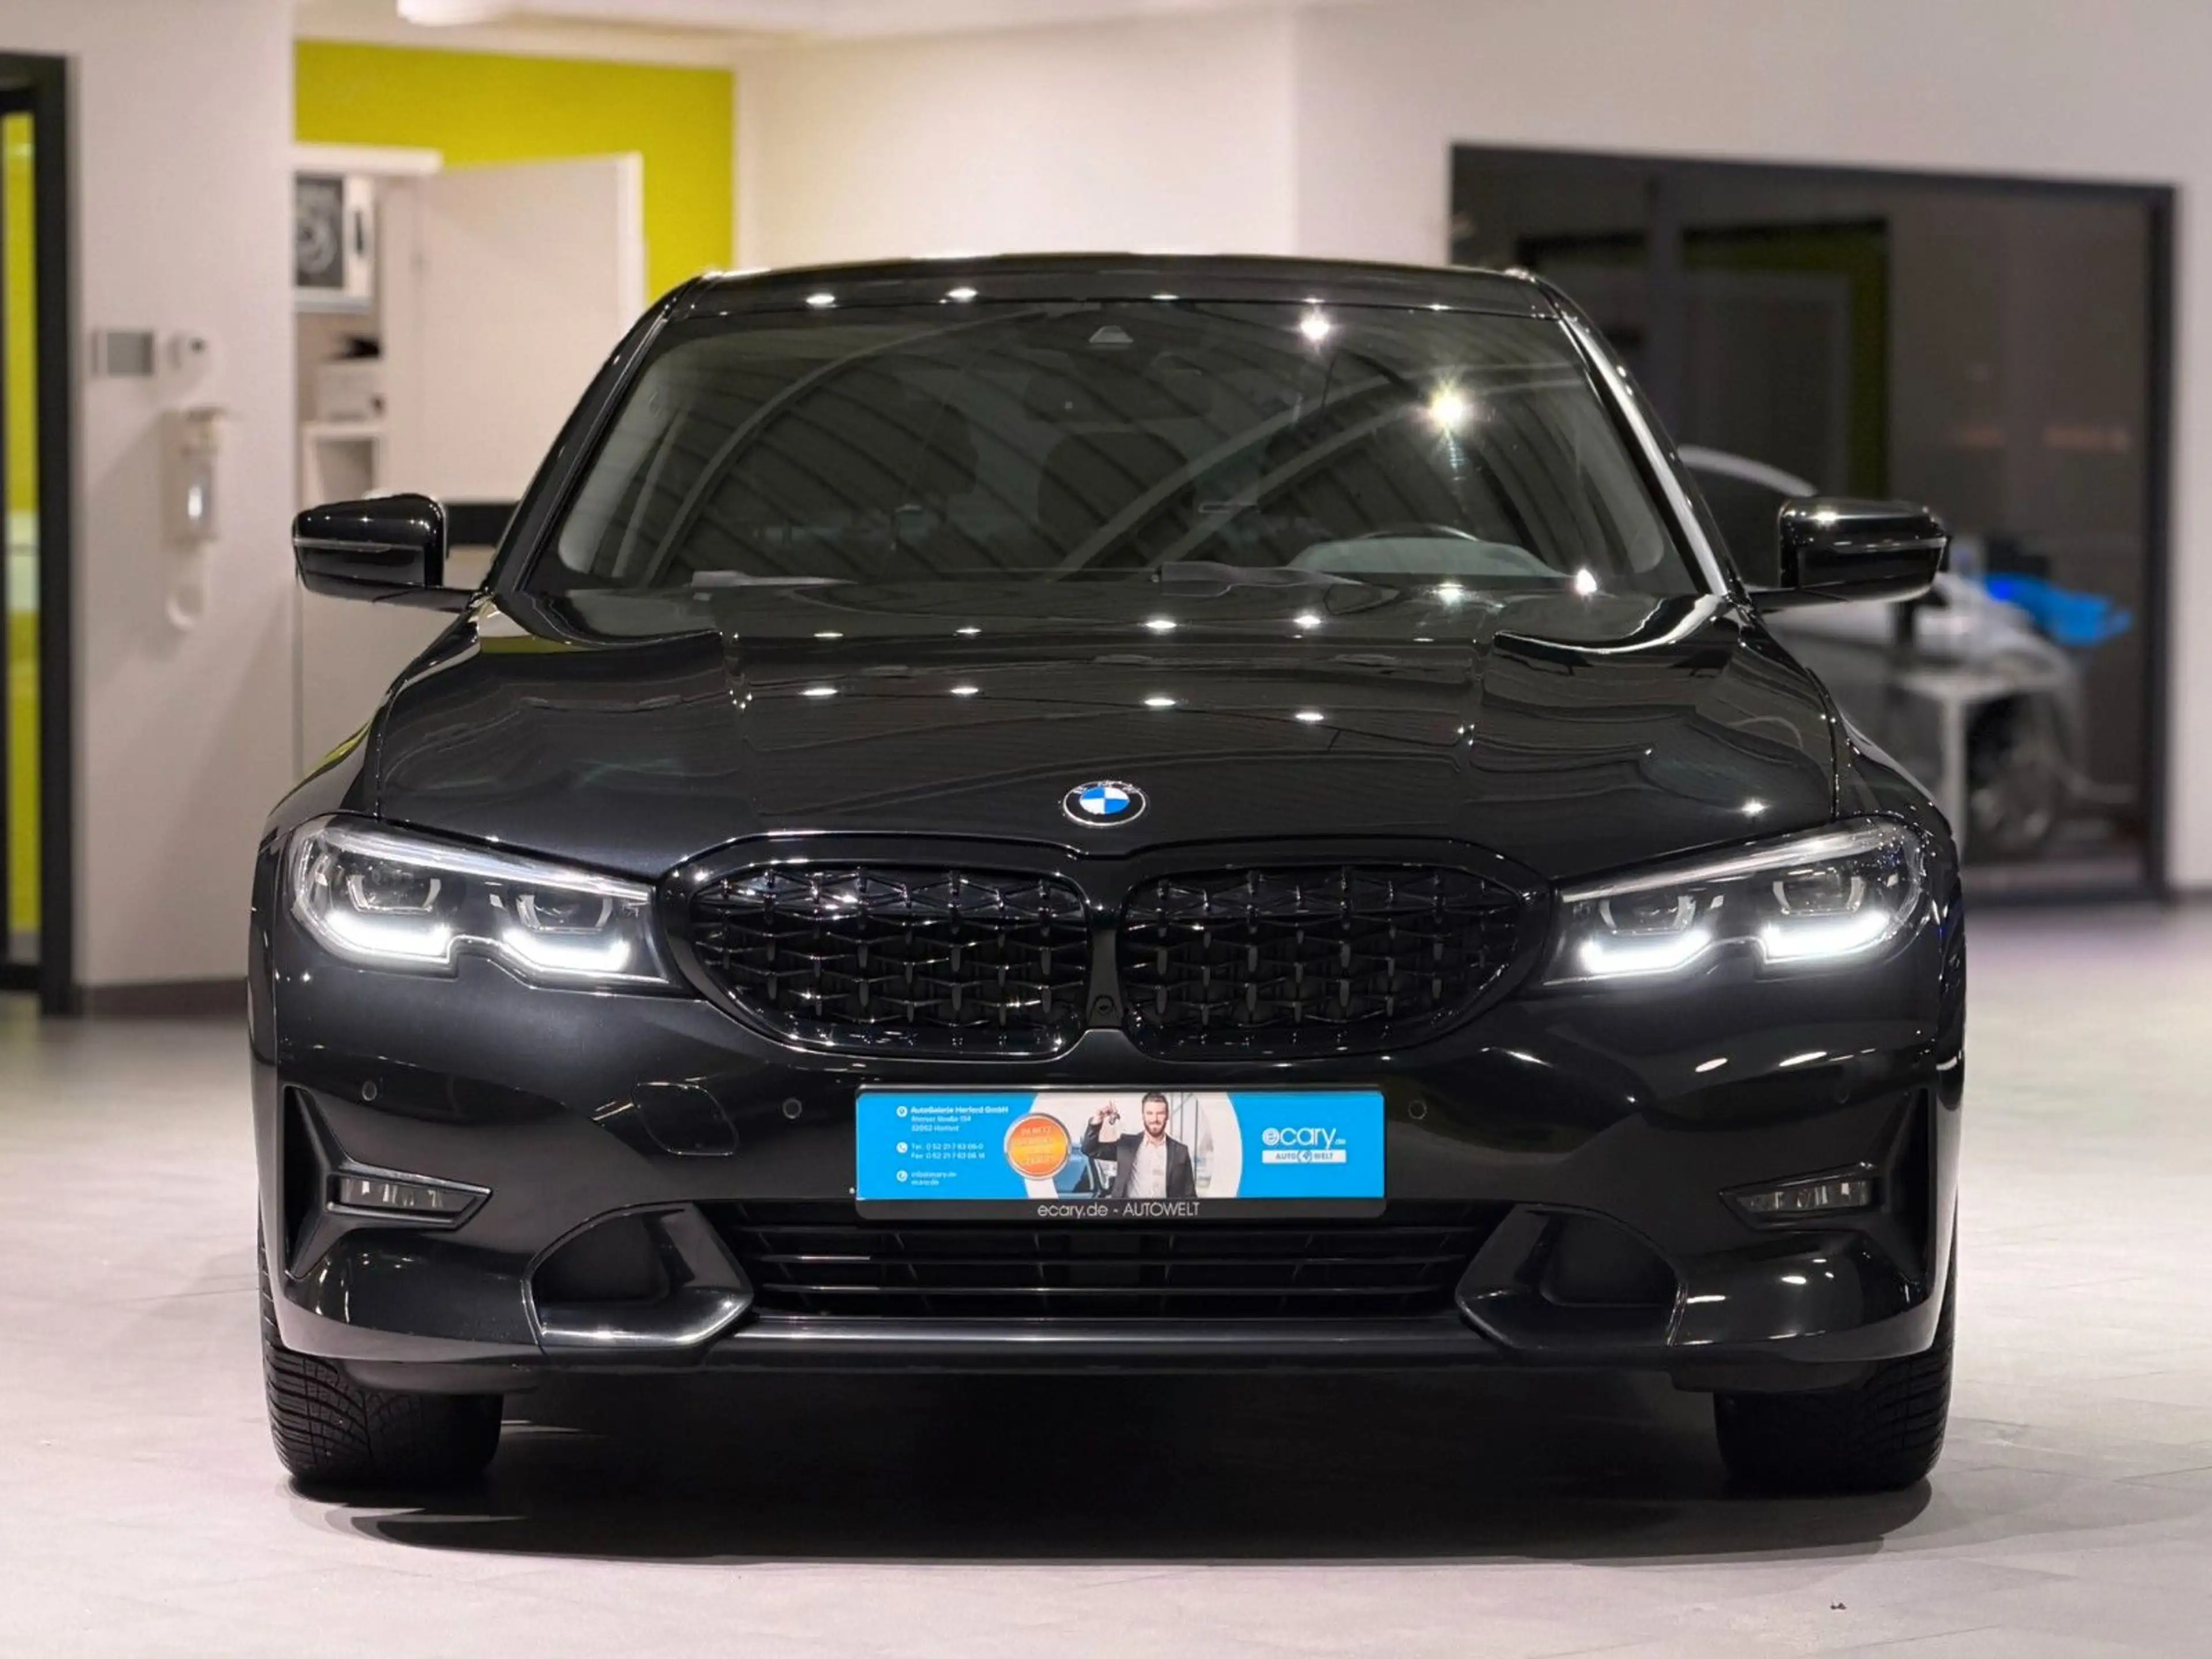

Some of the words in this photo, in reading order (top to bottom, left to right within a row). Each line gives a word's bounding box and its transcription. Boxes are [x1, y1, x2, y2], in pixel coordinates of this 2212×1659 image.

[984, 1106, 1009, 1114] GmbH
[1275, 1152, 1296, 1160] AUTO
[1314, 1152, 1334, 1160] WELT
[1037, 1202, 1108, 1219] ecary.de
[1123, 1202, 1200, 1217] AUTOWELT
